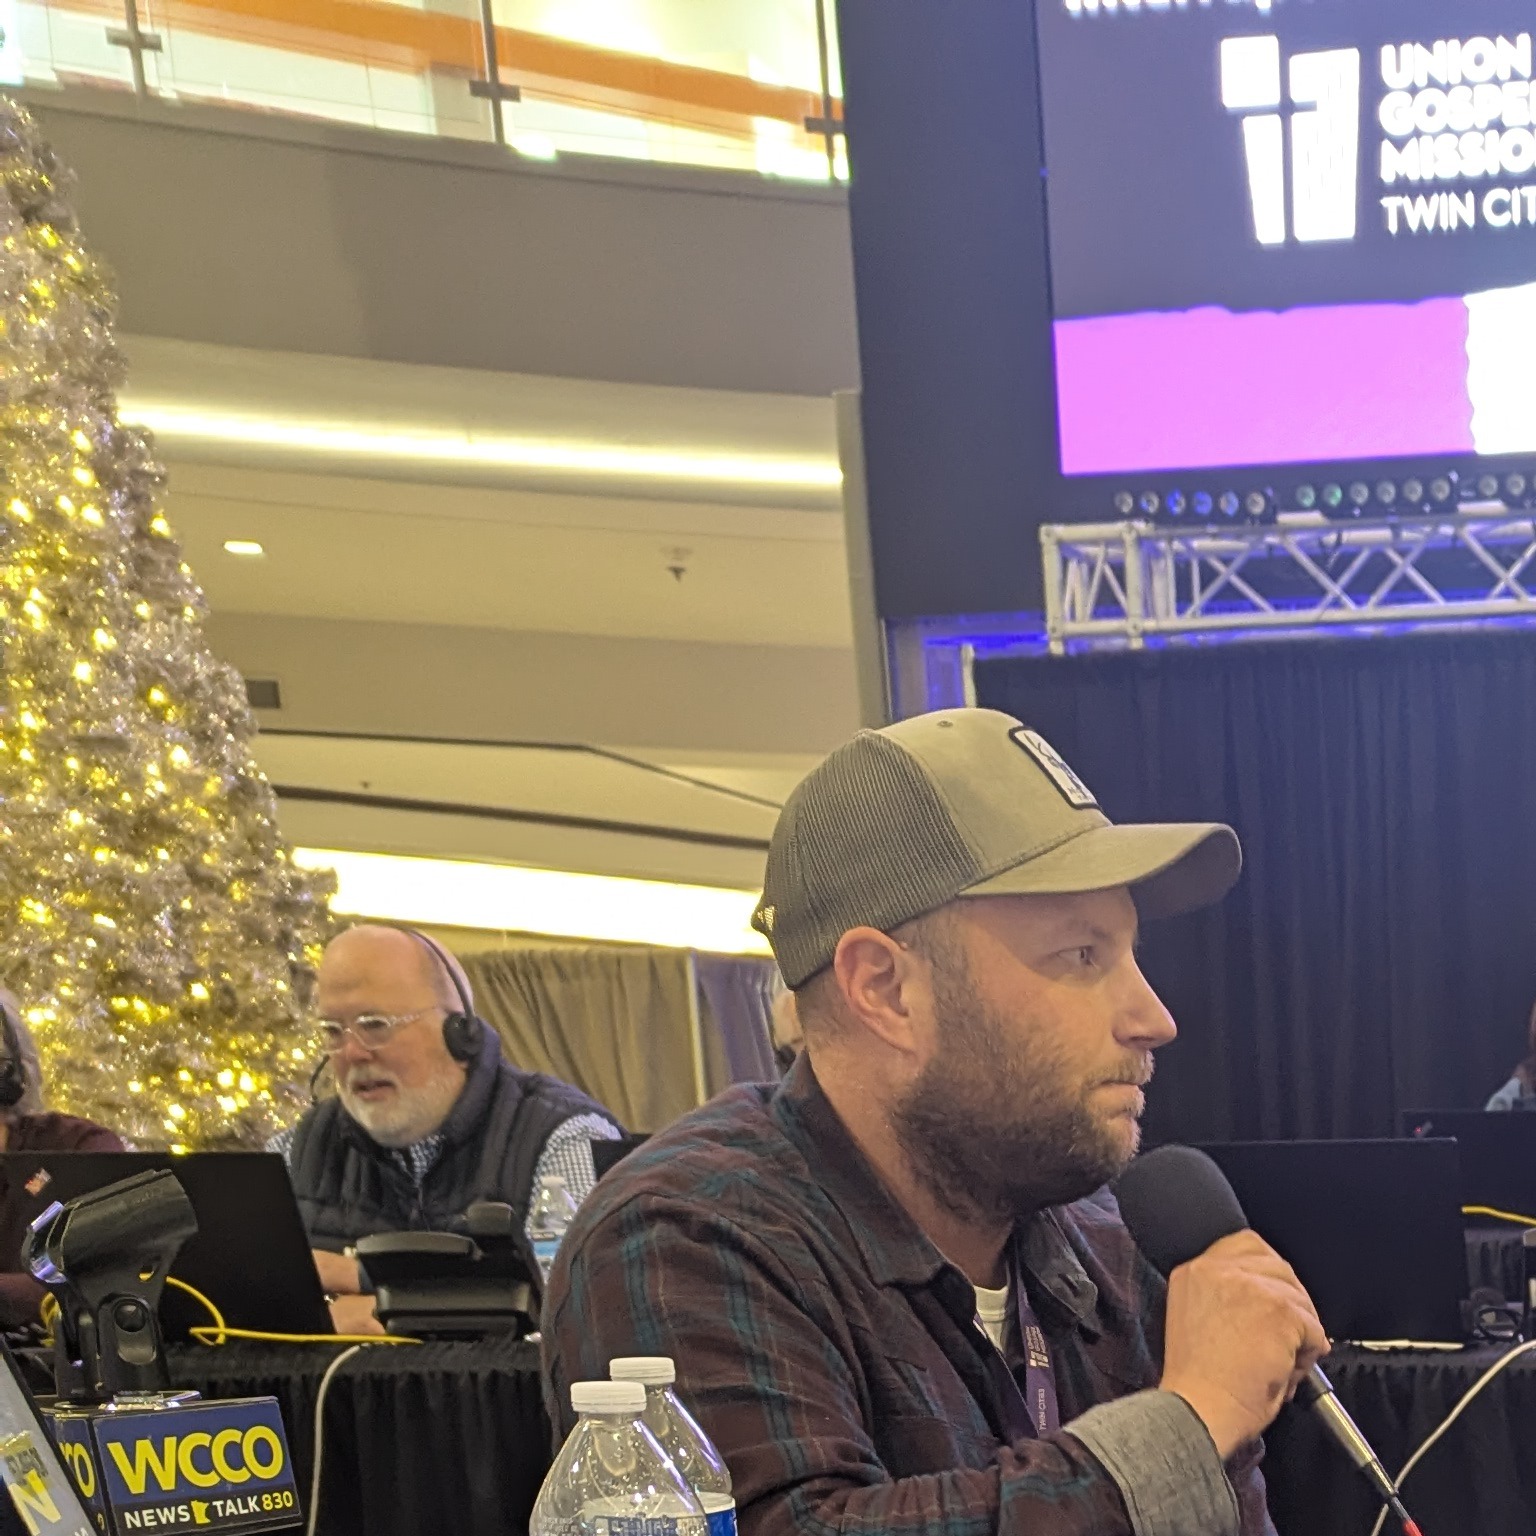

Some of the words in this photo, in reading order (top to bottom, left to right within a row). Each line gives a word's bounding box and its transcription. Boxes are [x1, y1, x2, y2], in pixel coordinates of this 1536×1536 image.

[1380, 34, 1533, 84] UNION
[1379, 193, 1475, 235] TWIN
[107, 1425, 284, 1494] WCCO
[124, 1504, 190, 1530] NEWS
[212, 1495, 259, 1518] TALK
[261, 1491, 294, 1511] 830
